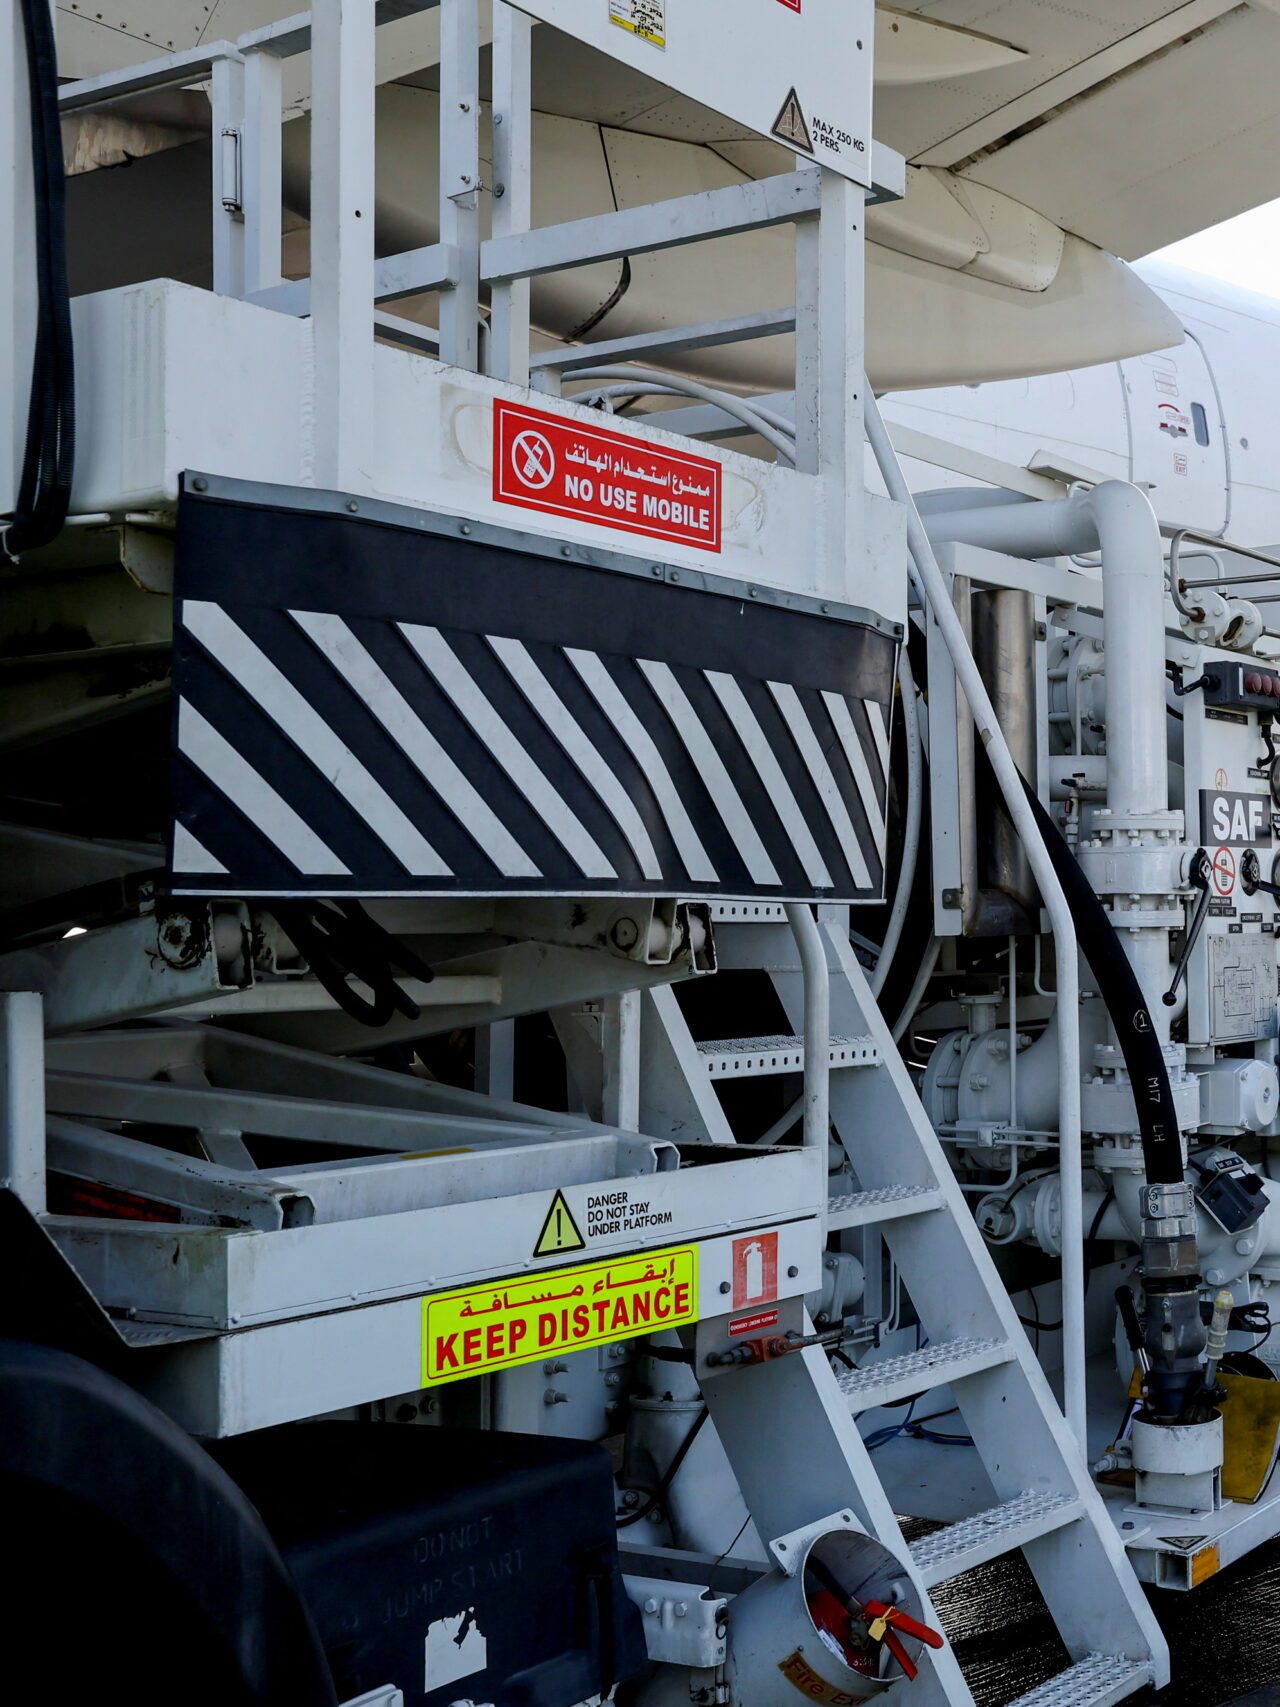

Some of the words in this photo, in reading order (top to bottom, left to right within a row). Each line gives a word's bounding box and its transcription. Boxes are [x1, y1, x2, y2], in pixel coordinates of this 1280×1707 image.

[813, 117, 835, 137] MAX
[836, 129, 851, 146] 250
[853, 138, 865, 153] KG
[813, 131, 819, 144] 2
[820, 134, 841, 154] PERS.
[564, 442, 612, 473] الهاتف
[564, 474, 594, 502] NO
[599, 483, 637, 513] USE
[643, 494, 710, 531] MOBILE
[671, 473, 710, 498] ممنوع
[1212, 796, 1263, 841] SAF
[1152, 1124, 1166, 1142] LH
[587, 1191, 628, 1208] DANGER
[587, 1209, 603, 1223] DO
[605, 1206, 627, 1220] NOT
[629, 1202, 650, 1217] STAY
[588, 1221, 621, 1237] UNDER
[623, 1211, 673, 1232] PLATFORM
[592, 1258, 676, 1297] إبقاء
[459, 1284, 584, 1319] مسافة
[435, 1319, 528, 1372] KEEP
[538, 1282, 690, 1348] DISTANCE
[450, 1516, 493, 1553] NOT
[384, 1578, 442, 1624] JUMP
[785, 1657, 825, 1695] Fire
